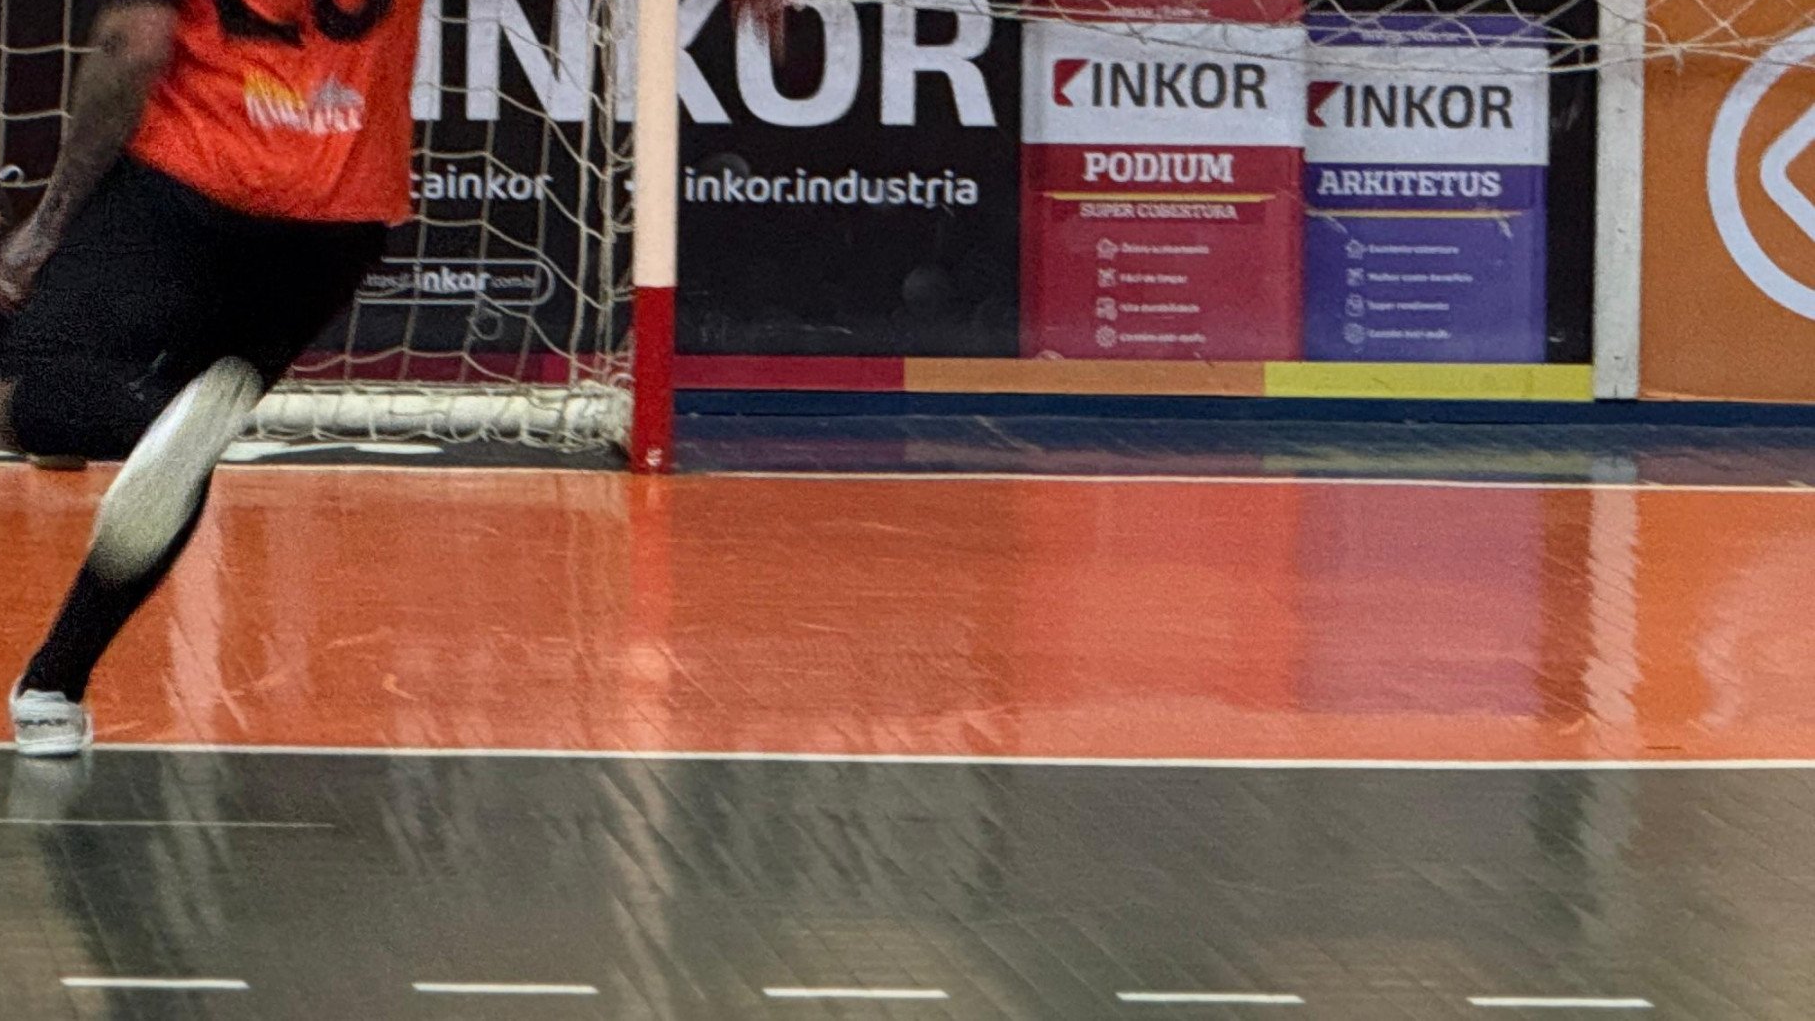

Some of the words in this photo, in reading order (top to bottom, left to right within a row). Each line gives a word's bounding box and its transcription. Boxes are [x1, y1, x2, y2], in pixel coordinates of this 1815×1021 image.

[1091, 62, 1267, 109] INKOR
[1345, 84, 1513, 129] INKOR
[1083, 152, 1234, 183] PODIUM
[1316, 169, 1502, 198] ARKITETUS
[684, 168, 979, 205] inkor.industria
